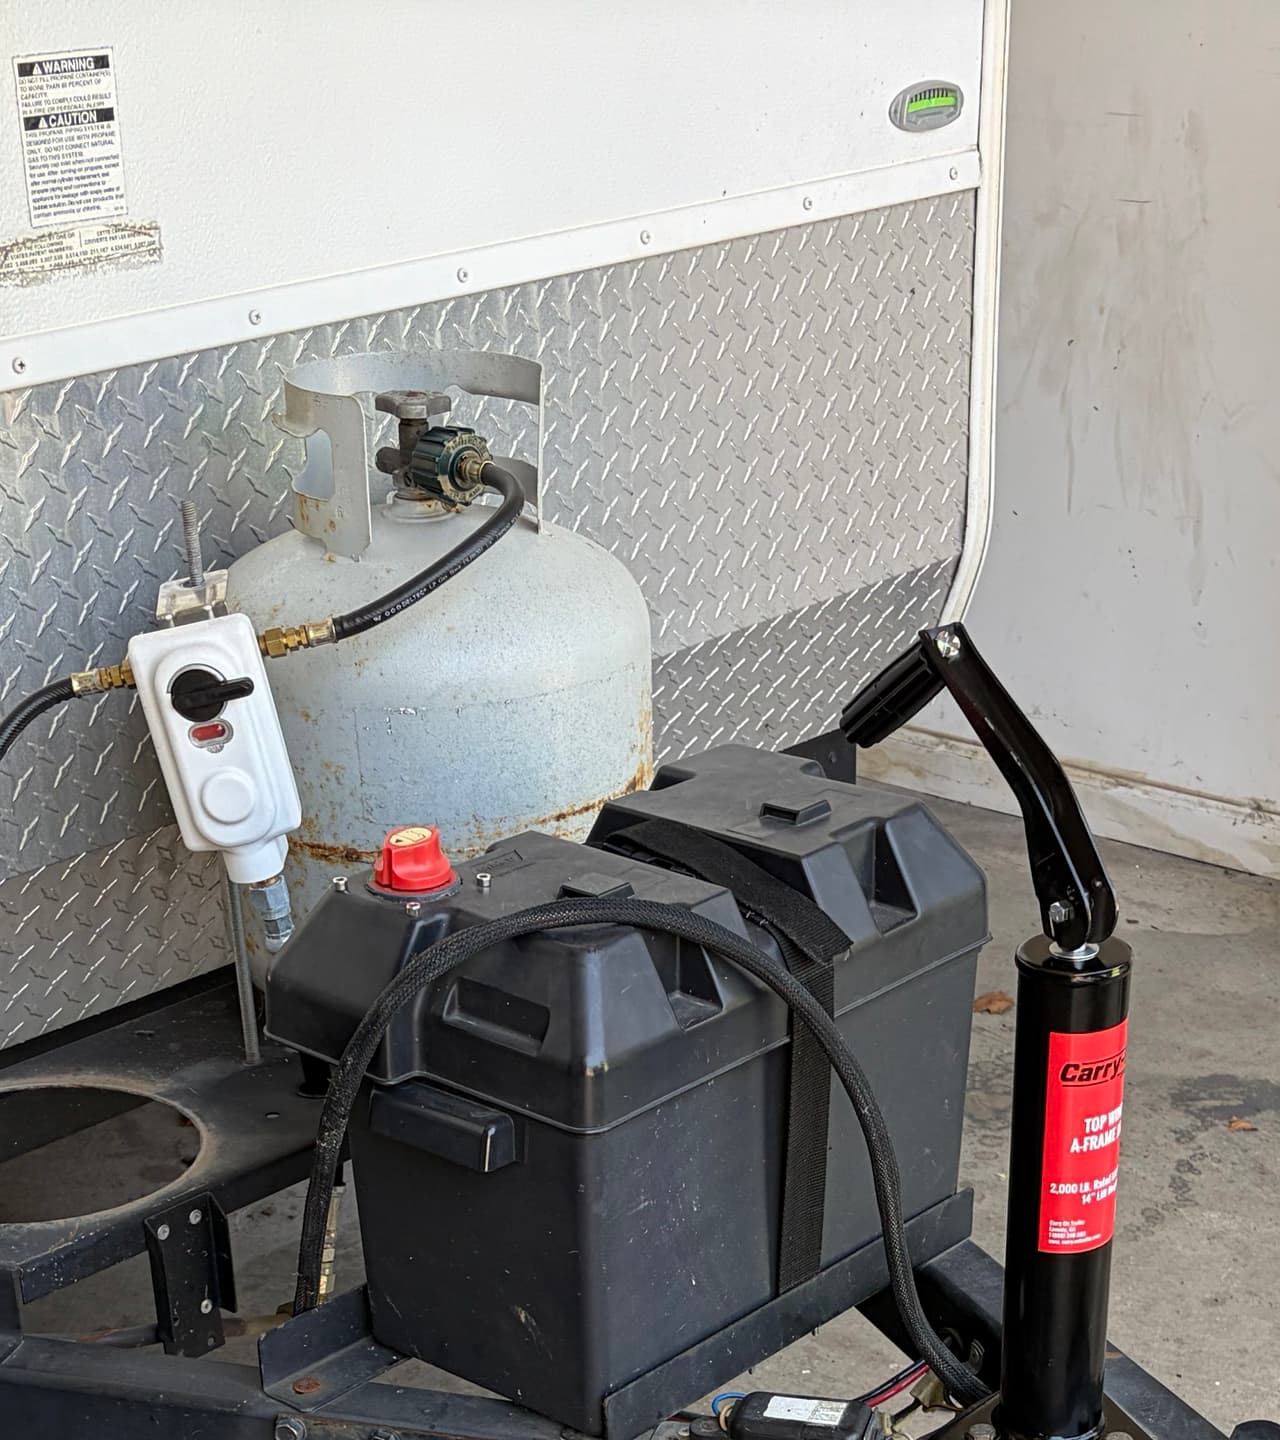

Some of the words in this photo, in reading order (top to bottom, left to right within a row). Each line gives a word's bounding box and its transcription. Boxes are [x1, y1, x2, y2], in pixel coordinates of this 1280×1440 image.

[42, 57, 95, 74] WARNING
[68, 79, 93, 88] PERCENT
[73, 95, 91, 103] COULD
[49, 111, 97, 127] CAUTION
[65, 142, 90, 151] CONNECT
[1084, 1114, 1107, 1134] TOP
[1070, 1126, 1117, 1153] A-FRAME
[1050, 1183, 1078, 1195] 2,000
